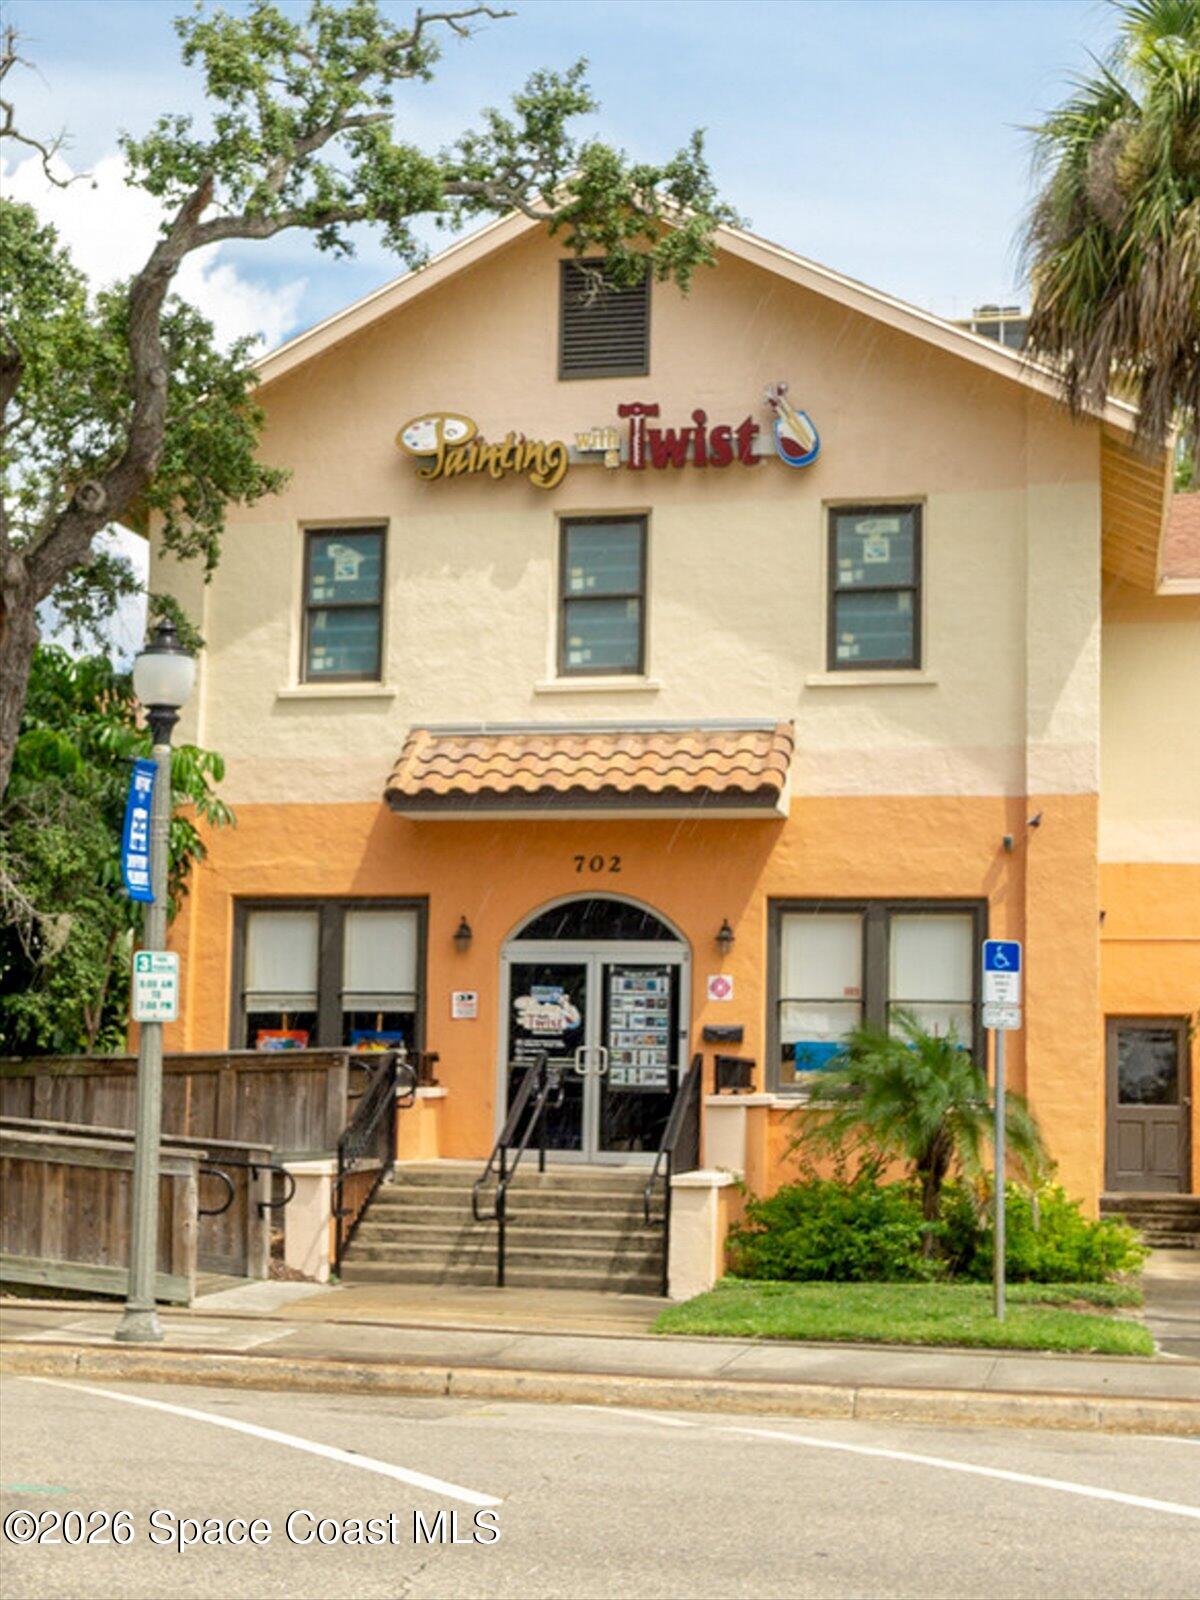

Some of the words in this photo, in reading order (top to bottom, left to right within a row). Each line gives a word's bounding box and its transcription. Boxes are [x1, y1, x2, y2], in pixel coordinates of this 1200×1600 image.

[395, 411, 570, 489] Painting
[574, 427, 620, 450] with
[618, 403, 760, 470] Twist
[573, 854, 622, 873] 702
